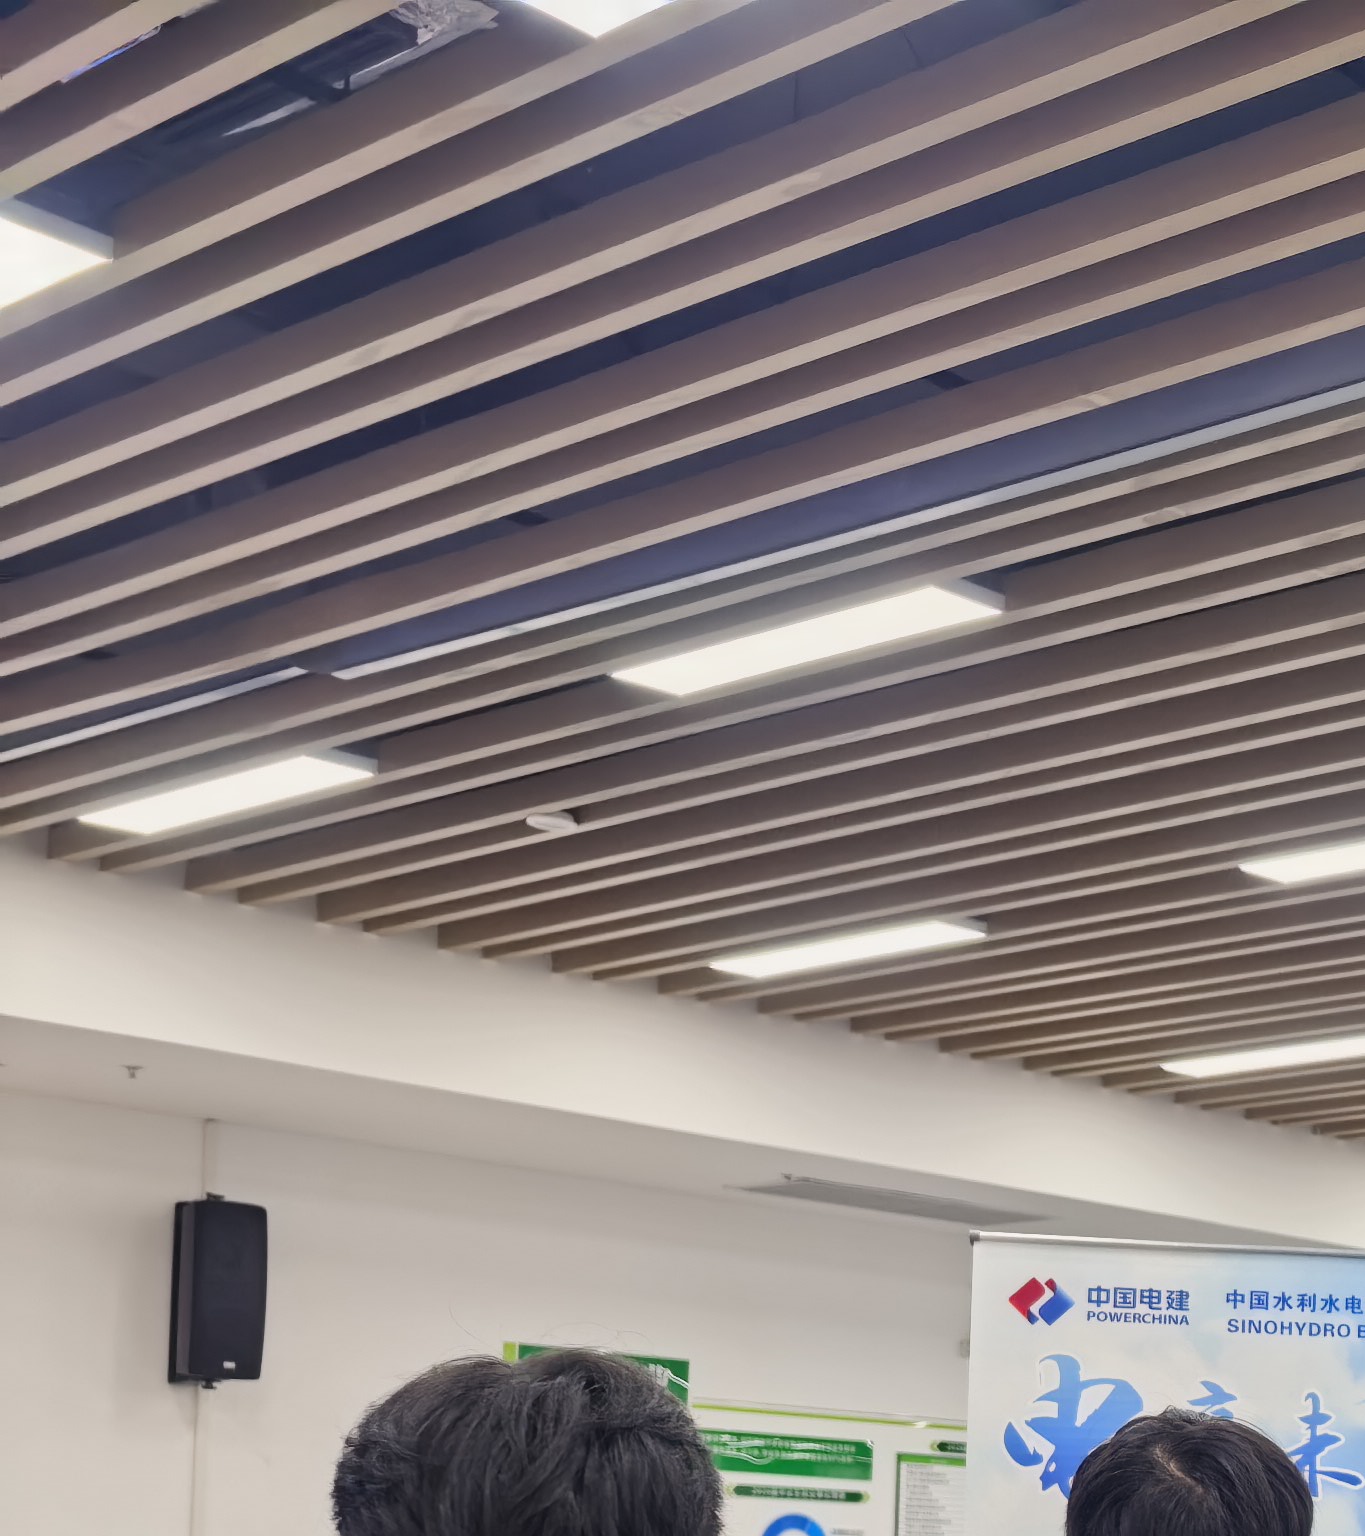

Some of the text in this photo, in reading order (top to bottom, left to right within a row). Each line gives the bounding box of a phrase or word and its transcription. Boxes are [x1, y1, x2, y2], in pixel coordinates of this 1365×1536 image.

[1087, 1285, 1190, 1311] 中国电建
[1086, 1311, 1190, 1326] POWERCHINA
[1227, 1318, 1351, 1338] SINOHYDRO
